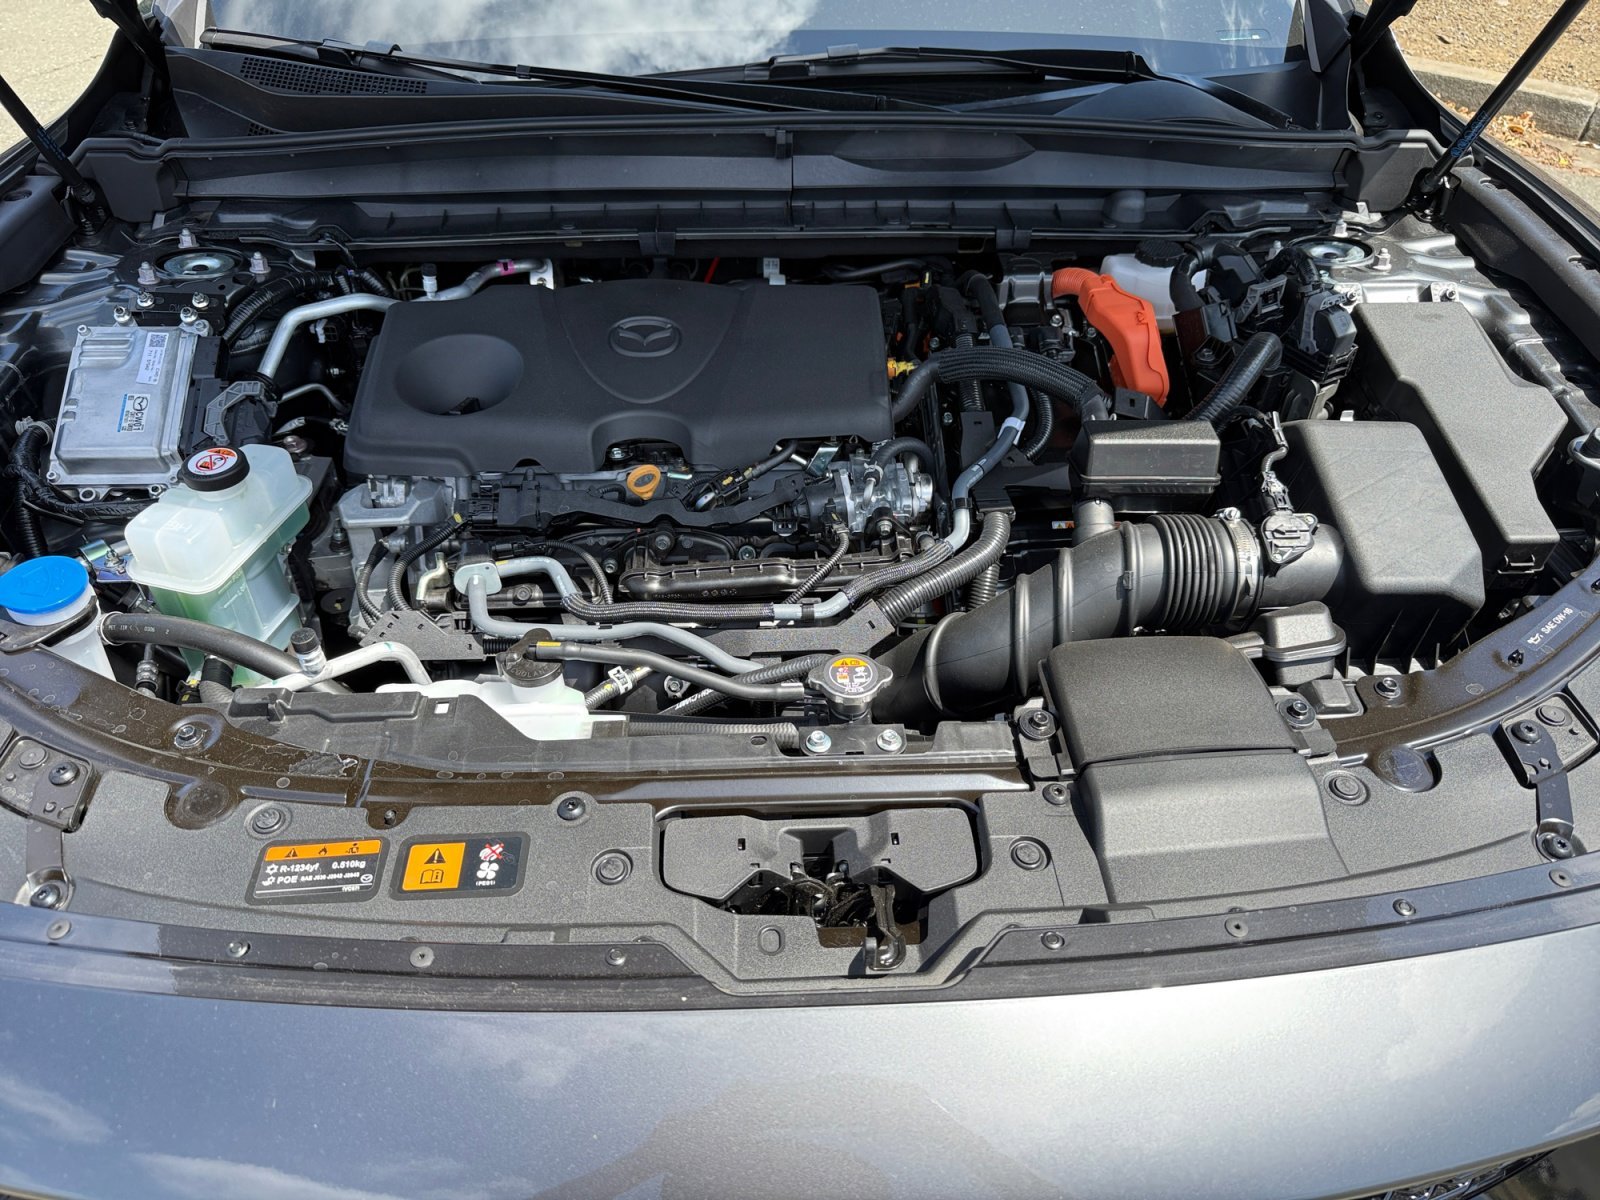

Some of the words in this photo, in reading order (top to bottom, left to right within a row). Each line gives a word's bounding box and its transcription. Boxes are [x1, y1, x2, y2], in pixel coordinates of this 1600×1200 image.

[133, 411, 145, 431] CW01
[1541, 621, 1557, 633] SAE
[1552, 607, 1573, 625] 0W-16
[510, 665, 550, 678] COOLANT
[279, 863, 319, 873] R-1234yf
[276, 875, 298, 884] POE
